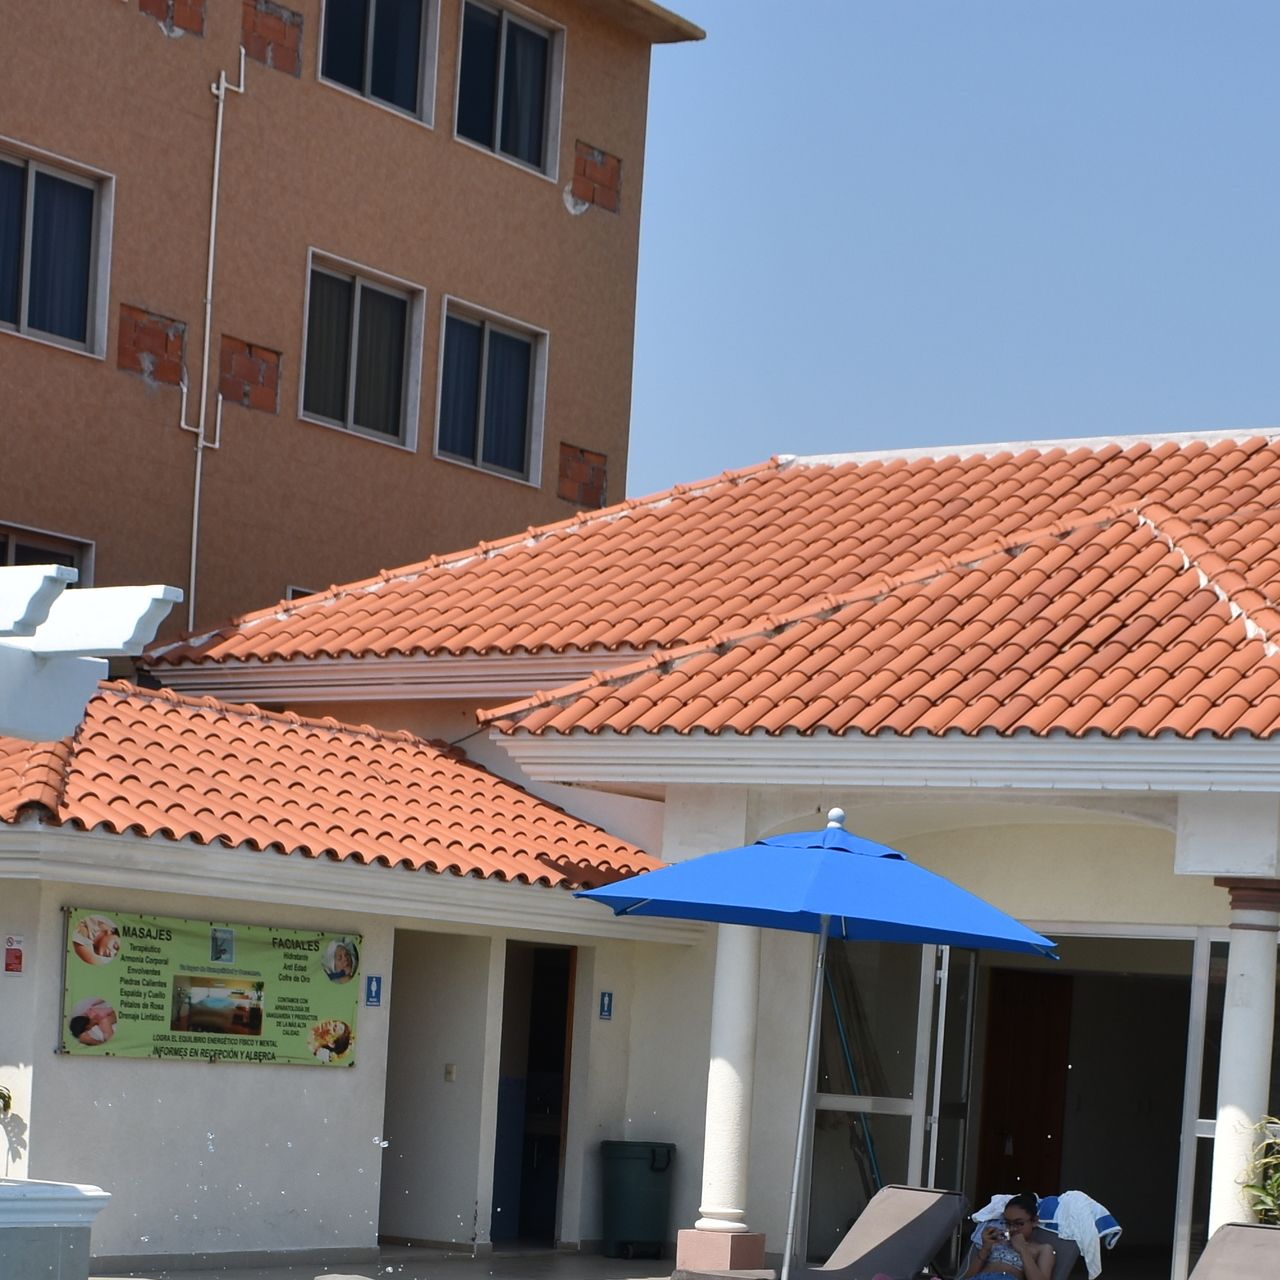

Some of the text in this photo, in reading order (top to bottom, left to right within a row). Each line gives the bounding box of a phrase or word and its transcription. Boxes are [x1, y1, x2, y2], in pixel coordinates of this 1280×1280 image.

[122, 925, 172, 941] MASAJES
[272, 937, 320, 952] FACIALES
[141, 978, 167, 988] Calientes
[148, 990, 166, 999] Cuello
[149, 1001, 164, 1010] Rosa
[152, 1034, 171, 1042] LOGRA
[178, 1035, 207, 1044] EQUILIBRIO
[152, 1046, 189, 1057] INFORMES
[189, 1047, 200, 1057] EN
[239, 1050, 245, 1060] Y
[245, 1050, 276, 1062] ALBERCA
